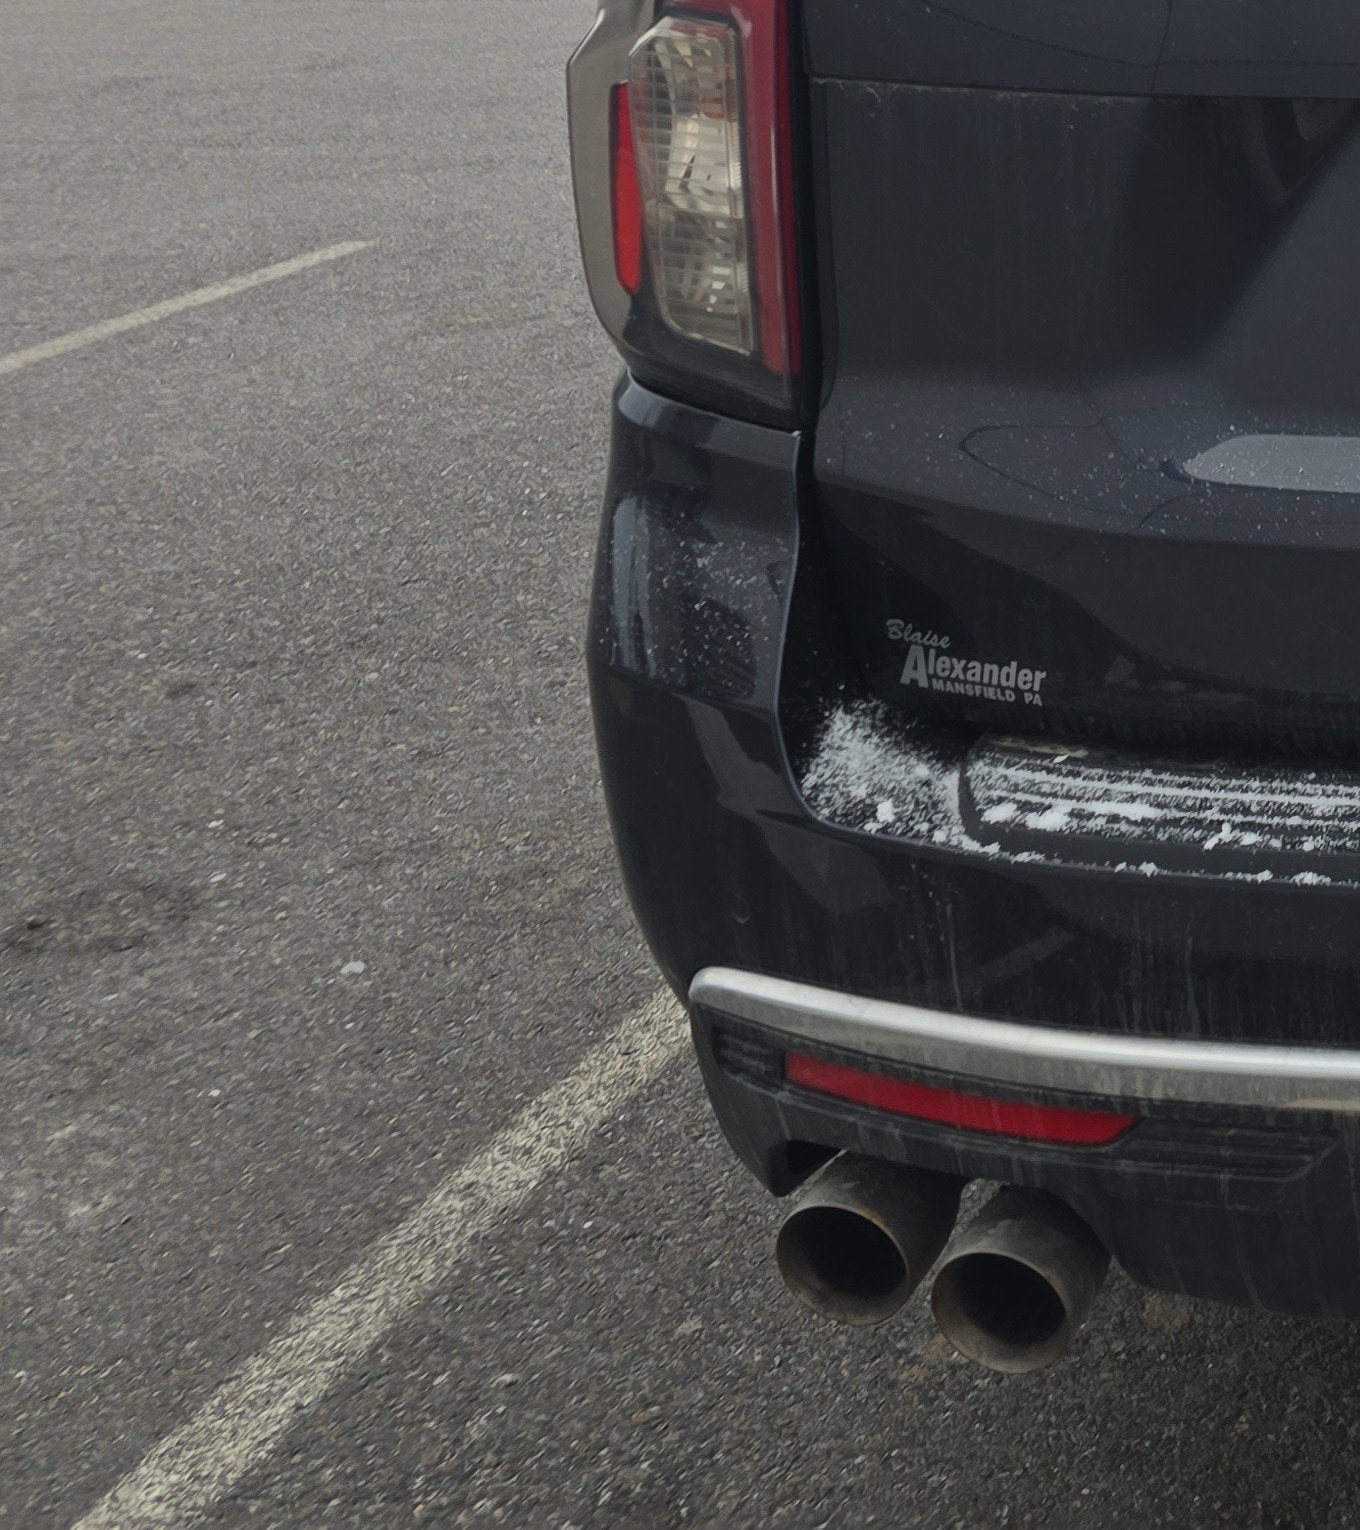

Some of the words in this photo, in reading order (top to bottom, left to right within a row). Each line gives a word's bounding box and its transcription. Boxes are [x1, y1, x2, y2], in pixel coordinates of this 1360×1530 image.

[886, 619, 951, 649] Blaise
[900, 645, 1047, 693] Alexander
[932, 678, 1015, 703] MANSFIELD
[1023, 692, 1043, 706] PA
